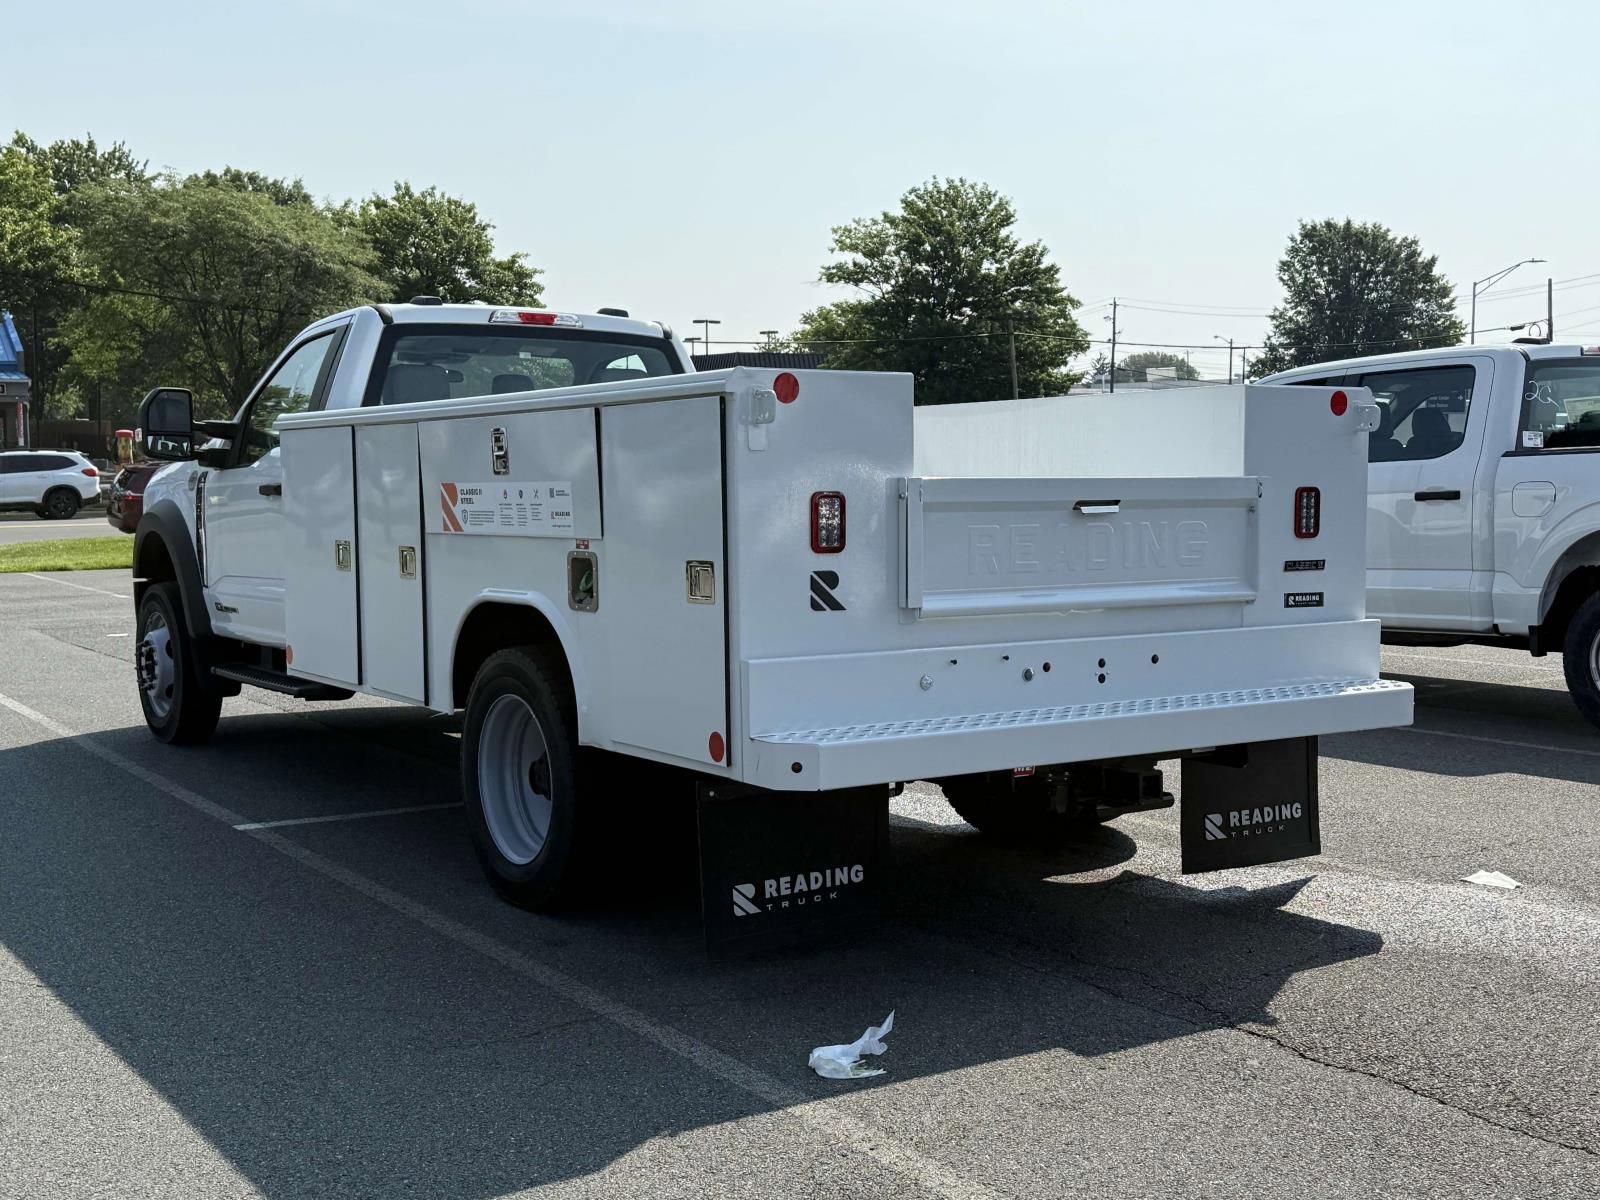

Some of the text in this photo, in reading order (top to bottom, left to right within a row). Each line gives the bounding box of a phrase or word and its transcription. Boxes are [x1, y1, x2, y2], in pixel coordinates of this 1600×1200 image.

[460, 488, 479, 496] CLASSIC
[967, 520, 1209, 576] READING
[1295, 594, 1320, 602] READING
[1229, 802, 1302, 828] READING
[1231, 824, 1285, 839] TRUCK
[764, 864, 864, 899] READING
[766, 891, 838, 911] TRUCK
